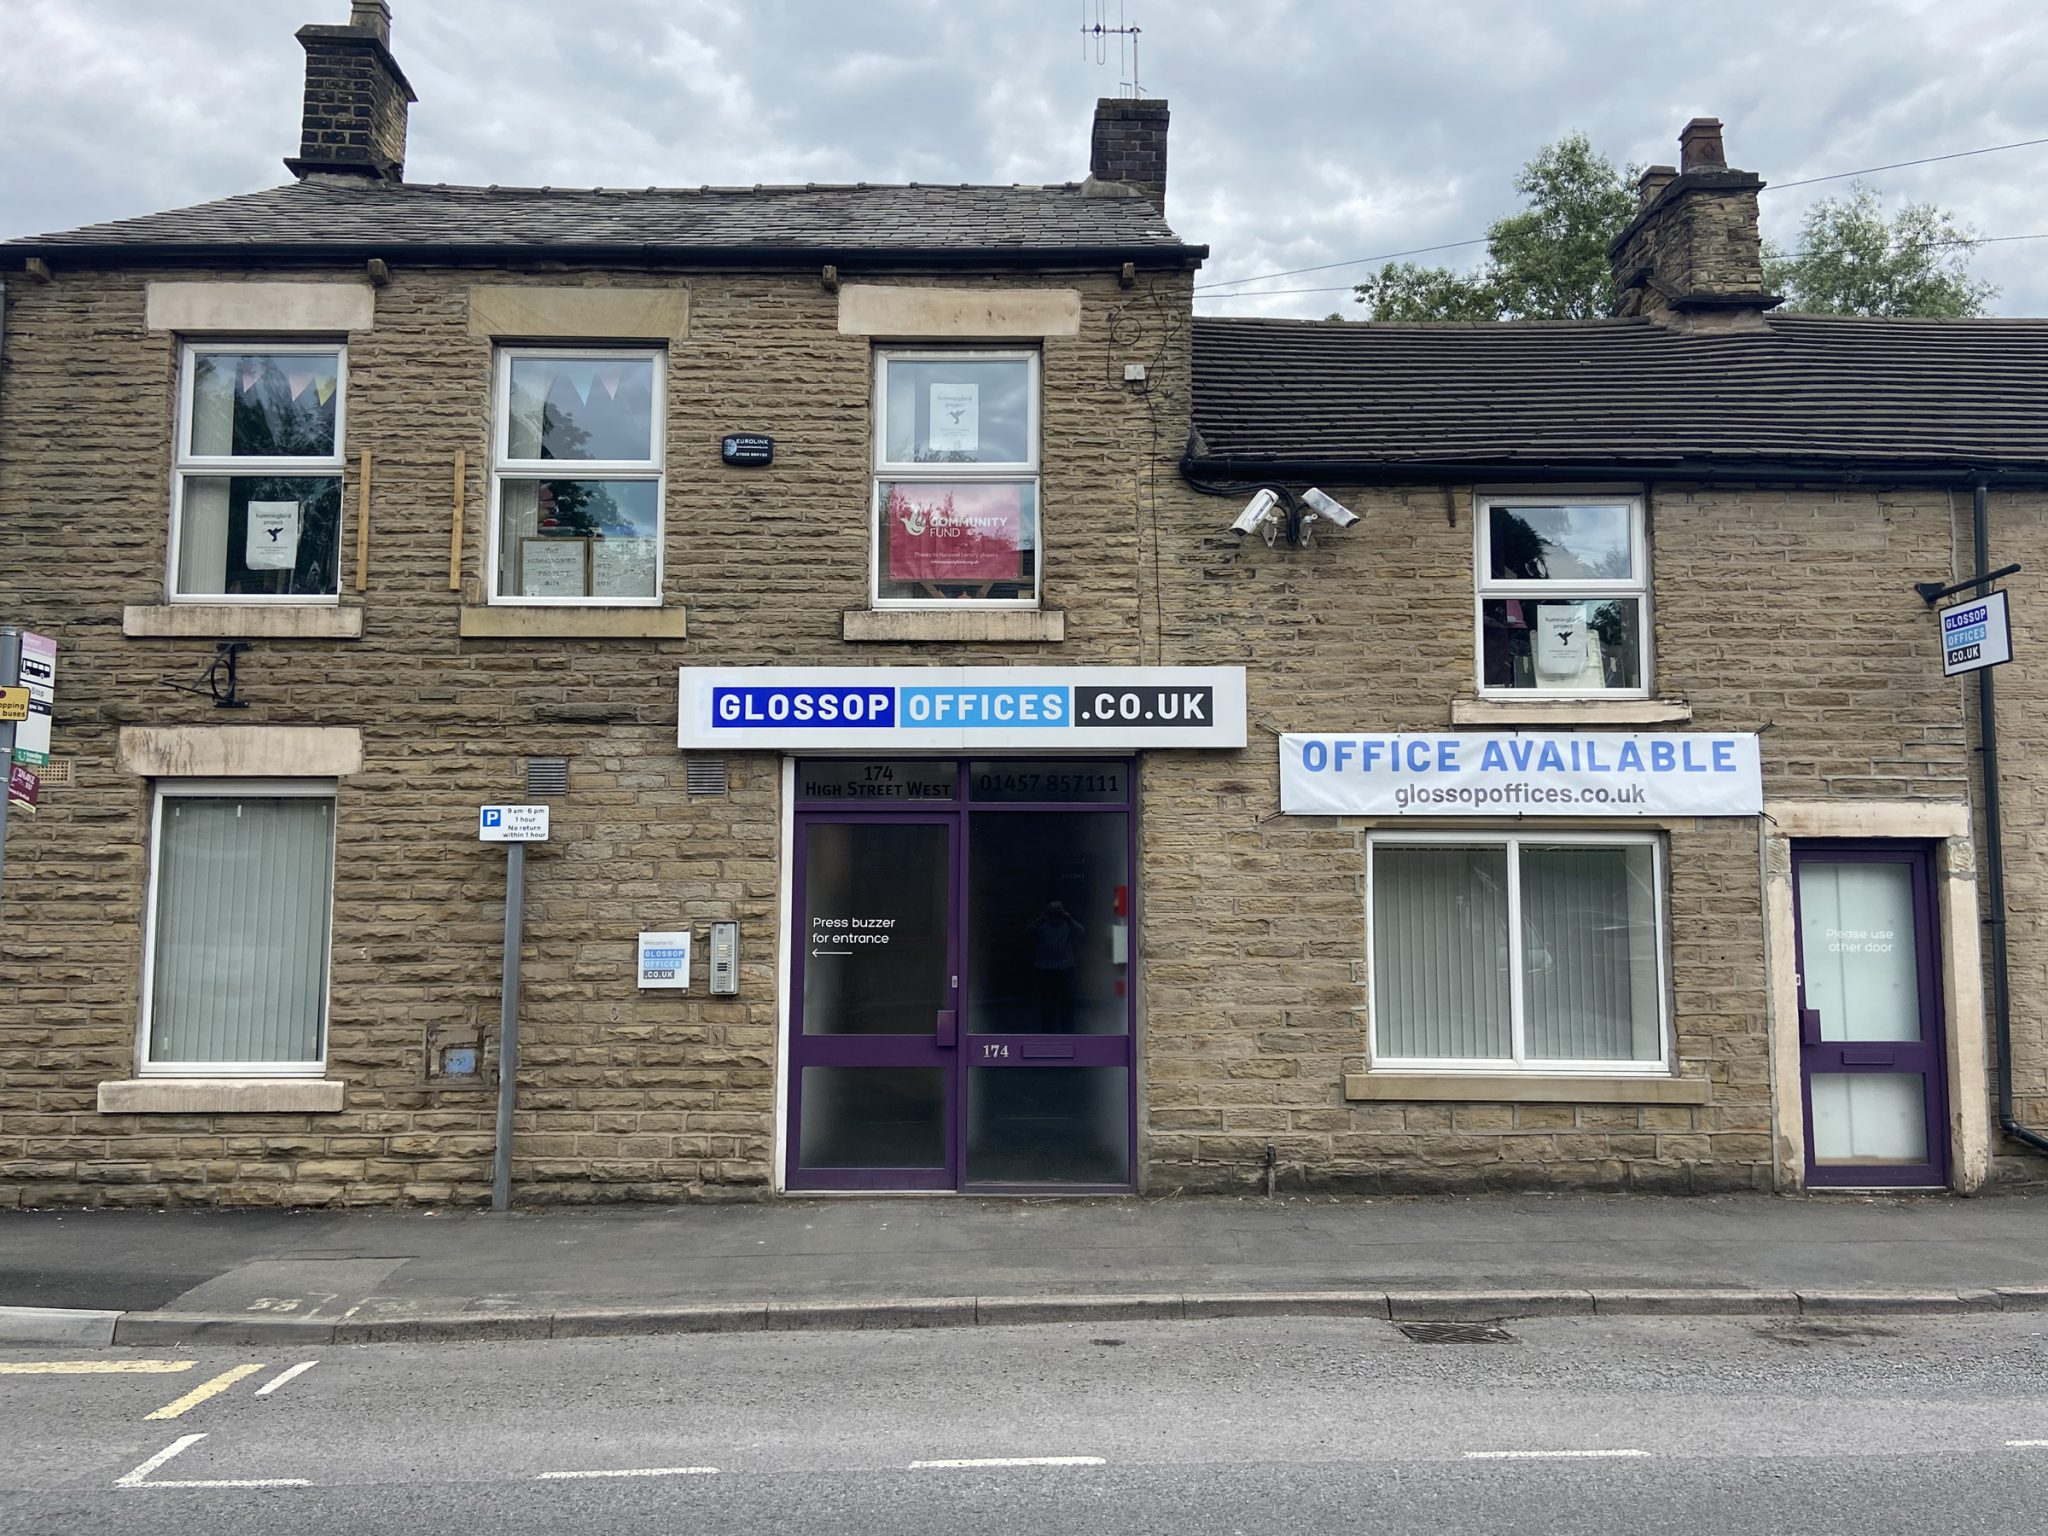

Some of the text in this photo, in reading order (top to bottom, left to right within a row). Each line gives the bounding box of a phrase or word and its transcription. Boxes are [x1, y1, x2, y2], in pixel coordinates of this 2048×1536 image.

[929, 516, 1009, 528] COMMUNITY
[929, 527, 961, 538] FUND
[1945, 608, 1986, 629] GLOSSOP
[1948, 627, 1986, 646] OFFICES
[1949, 646, 1979, 663] .CO.UK
[31, 686, 44, 697] Stop
[719, 692, 1206, 721] GLOSSOP OFFICES .CO.UK
[2, 710, 26, 718] buses
[1302, 740, 1737, 773] OFFICE AVAILABLE
[863, 766, 894, 781] 174
[980, 775, 1118, 793] 01457 857111
[1394, 783, 1646, 808] glossopoffices.co.uk
[487, 811, 499, 826] P
[813, 917, 896, 928] Press buzzer
[812, 932, 889, 944] for entrance
[1826, 928, 1894, 939] Please use
[1828, 943, 1893, 952] other door
[644, 970, 674, 978] .CO.UK
[983, 1044, 1009, 1058] 174
